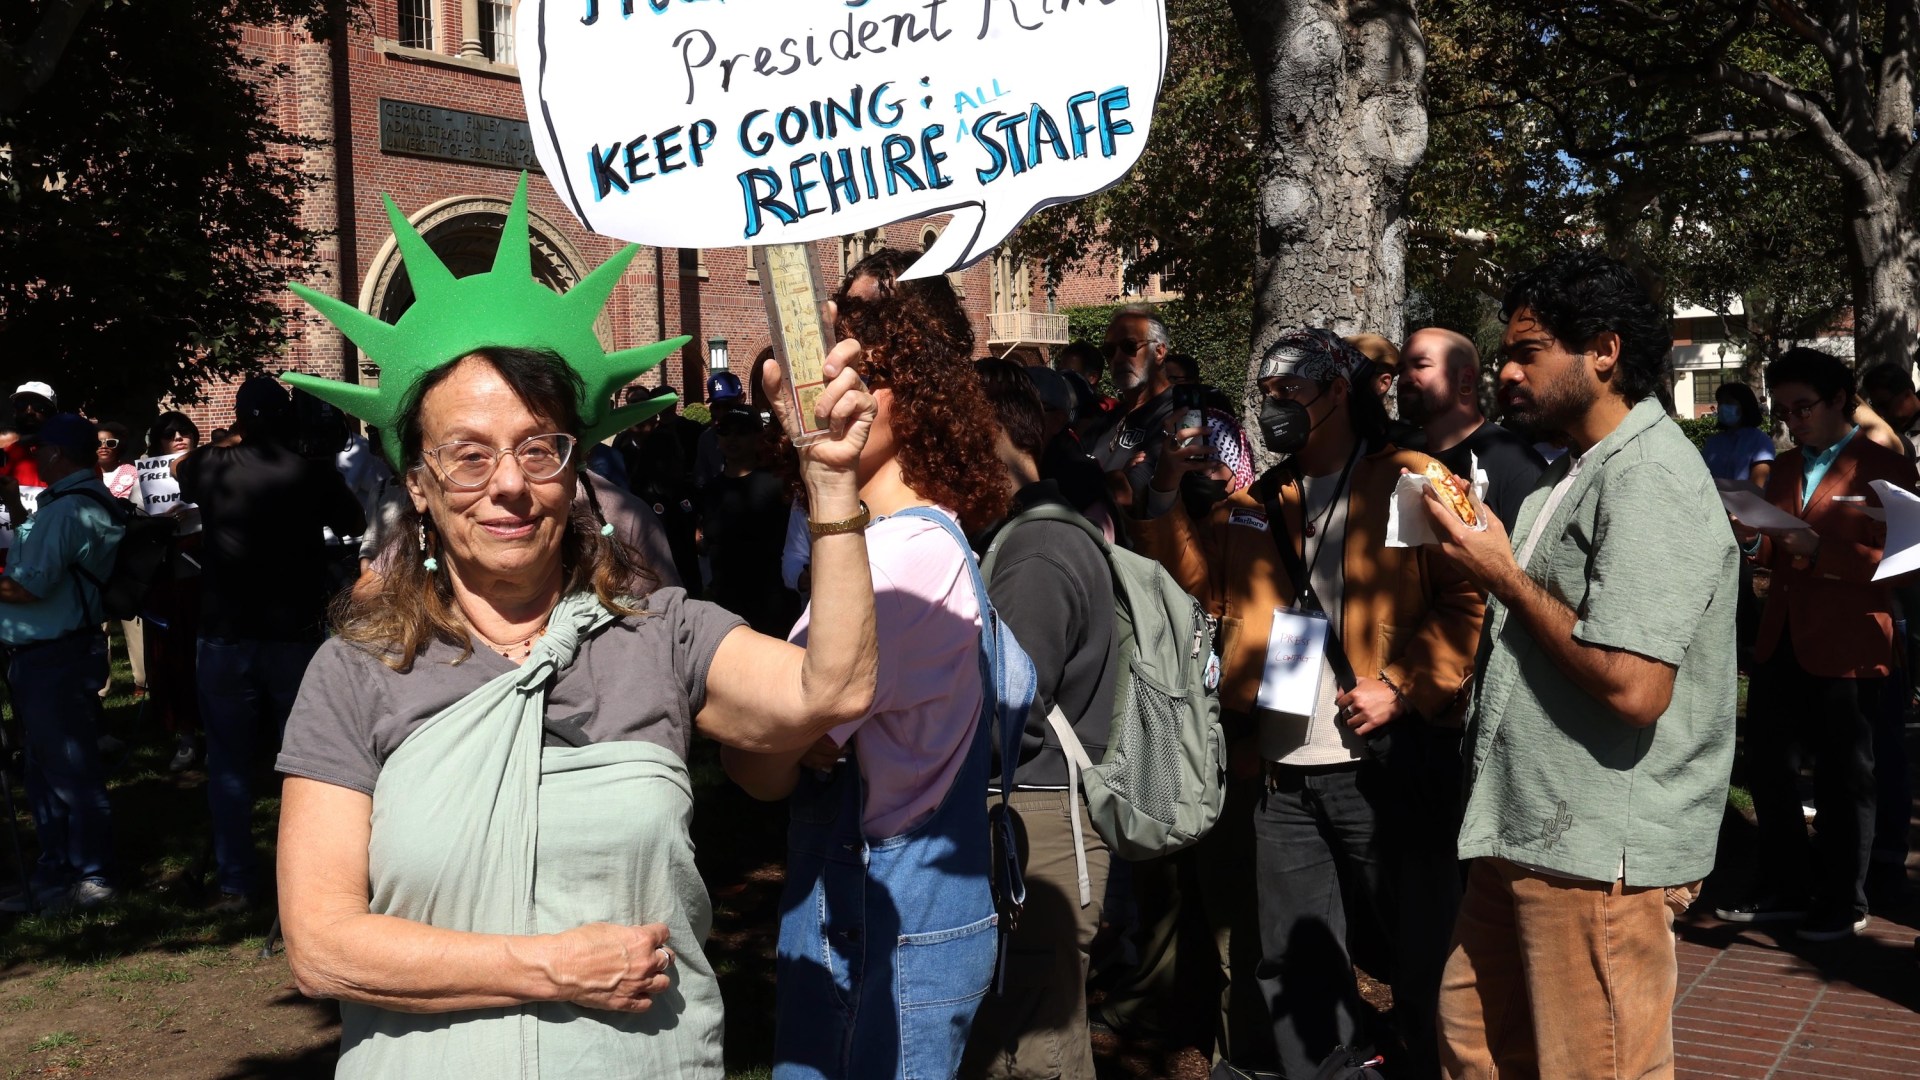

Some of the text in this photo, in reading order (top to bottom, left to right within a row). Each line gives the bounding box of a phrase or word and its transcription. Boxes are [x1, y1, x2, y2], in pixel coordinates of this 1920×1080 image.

[672, 0, 952, 105] President
[385, 104, 432, 123] GEORGE
[466, 116, 500, 133] FINLEY
[954, 78, 1011, 114] ALL
[386, 120, 481, 145] ADMINISTRATION
[587, 118, 717, 202] KEEP
[736, 85, 1134, 240] REHIRE STAFF
